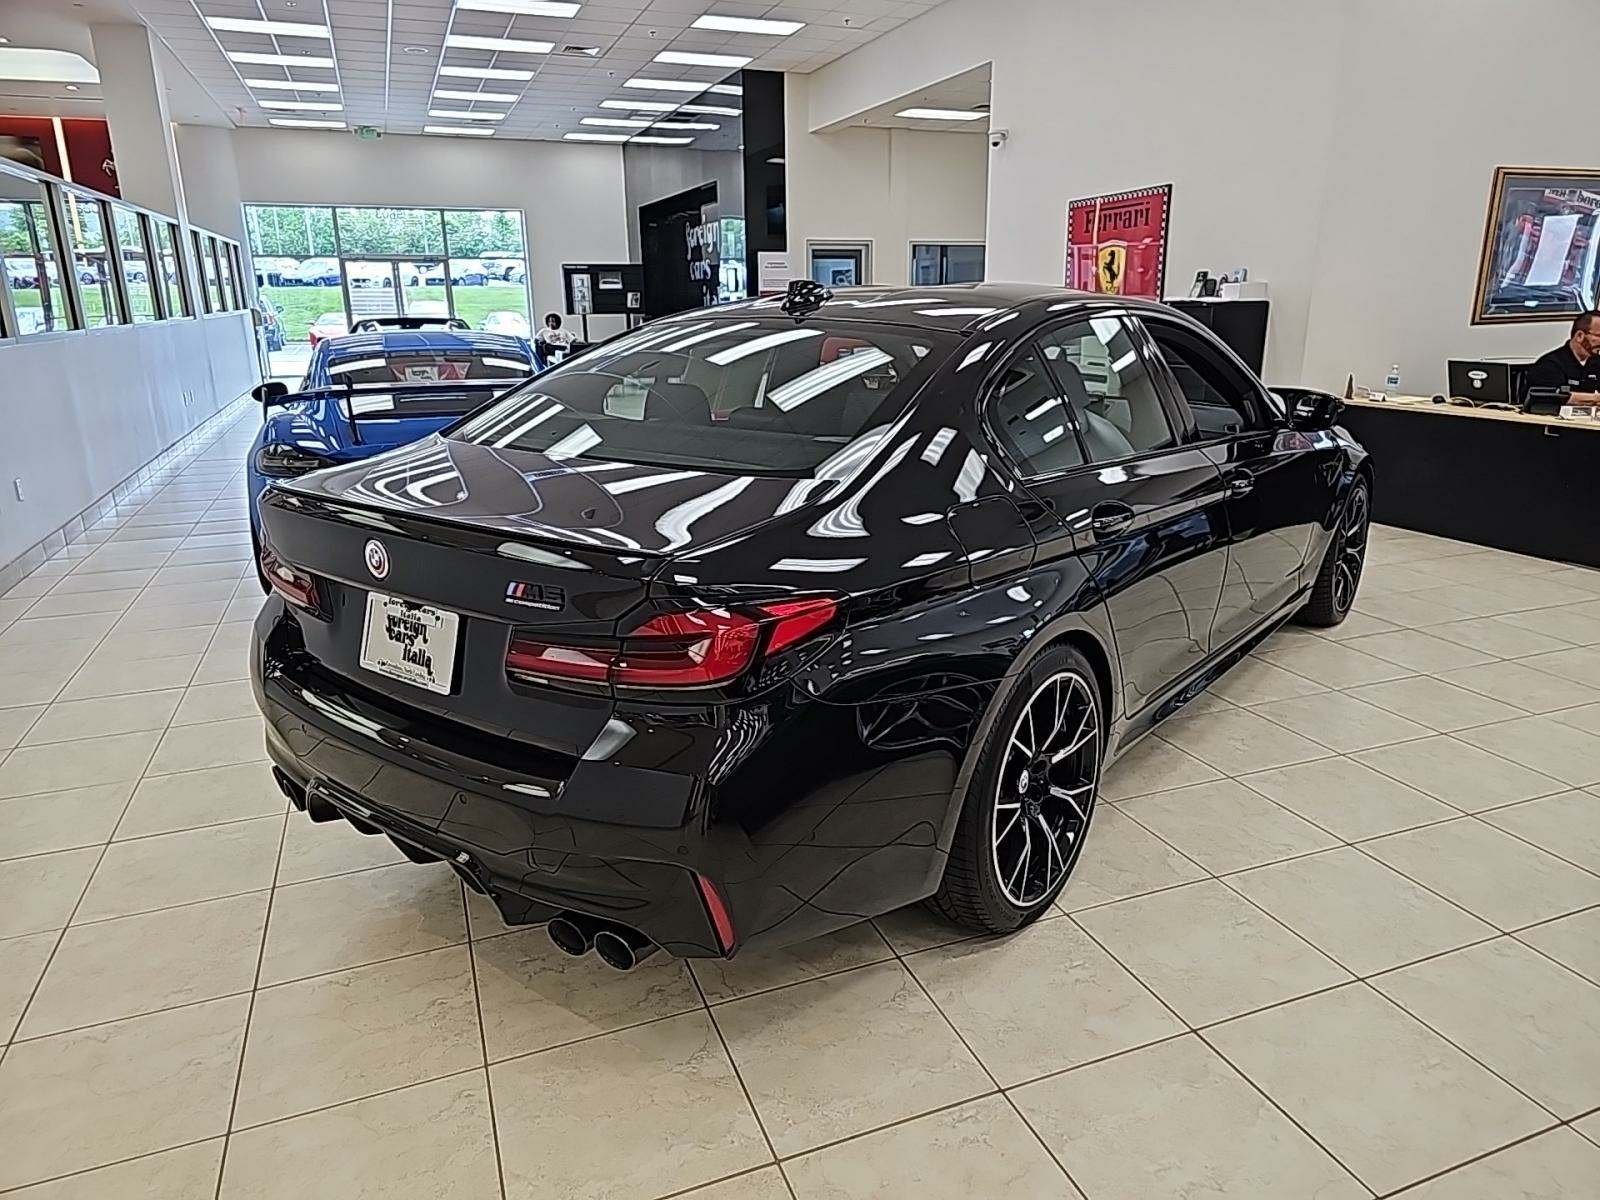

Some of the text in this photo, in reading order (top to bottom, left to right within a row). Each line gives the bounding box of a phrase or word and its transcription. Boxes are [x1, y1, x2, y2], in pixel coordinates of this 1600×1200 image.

[1084, 201, 1151, 234] Ferrari
[685, 214, 720, 260] foreign
[690, 259, 711, 281] cars
[386, 614, 429, 644] foreign
[388, 628, 416, 647] cars
